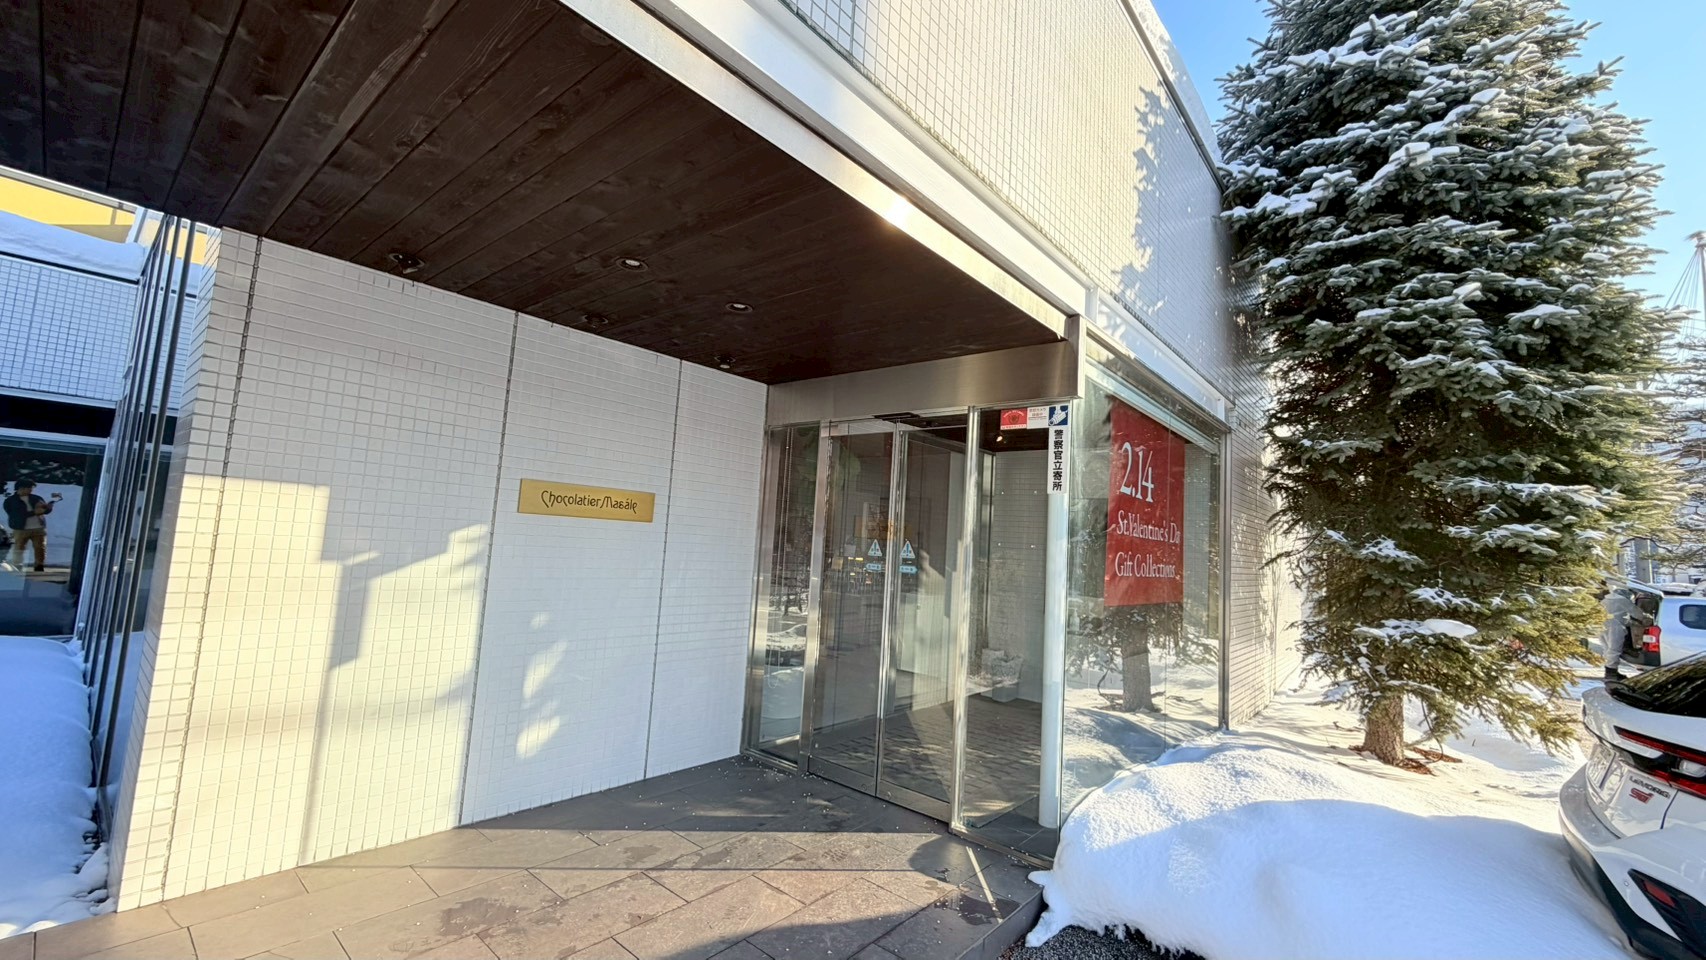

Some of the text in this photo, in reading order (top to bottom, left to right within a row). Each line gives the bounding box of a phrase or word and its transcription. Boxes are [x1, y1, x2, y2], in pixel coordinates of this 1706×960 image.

[1052, 429, 1063, 491] 警察官立寄所
[1120, 441, 1155, 503] 2.14
[541, 490, 601, 508] Chocolatier
[1115, 551, 1176, 578] Gift Collections
